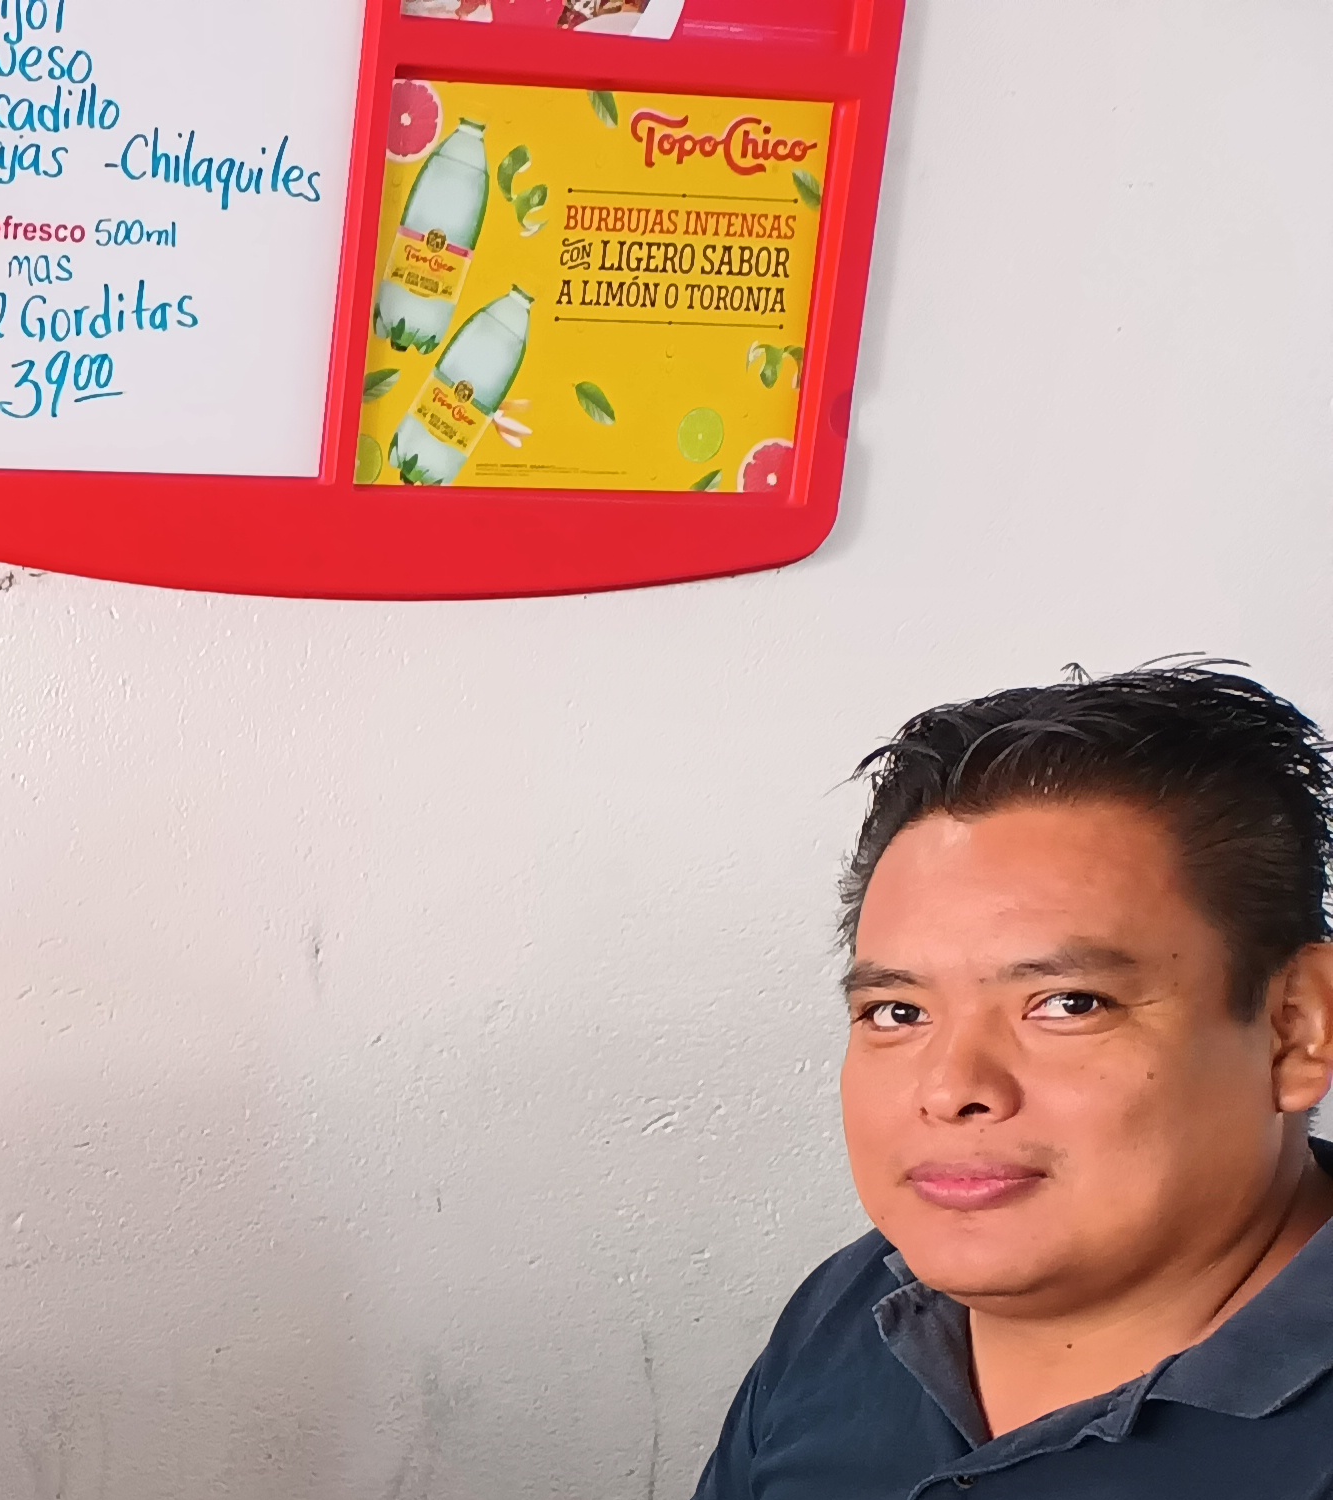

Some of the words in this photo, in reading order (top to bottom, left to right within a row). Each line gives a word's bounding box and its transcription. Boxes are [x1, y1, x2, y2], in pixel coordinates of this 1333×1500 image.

[564, 204, 679, 236] BURBUJAS
[683, 210, 797, 240] INTENSAS
[7, 254, 73, 285] mas
[560, 239, 594, 269] CON
[598, 240, 696, 274] LIGERO
[701, 245, 790, 278] SABOR
[20, 280, 199, 343] Gorditas
[556, 279, 573, 305] A
[579, 276, 661, 309] LIMÓN
[664, 283, 679, 309] O
[685, 284, 786, 315] TORONJA
